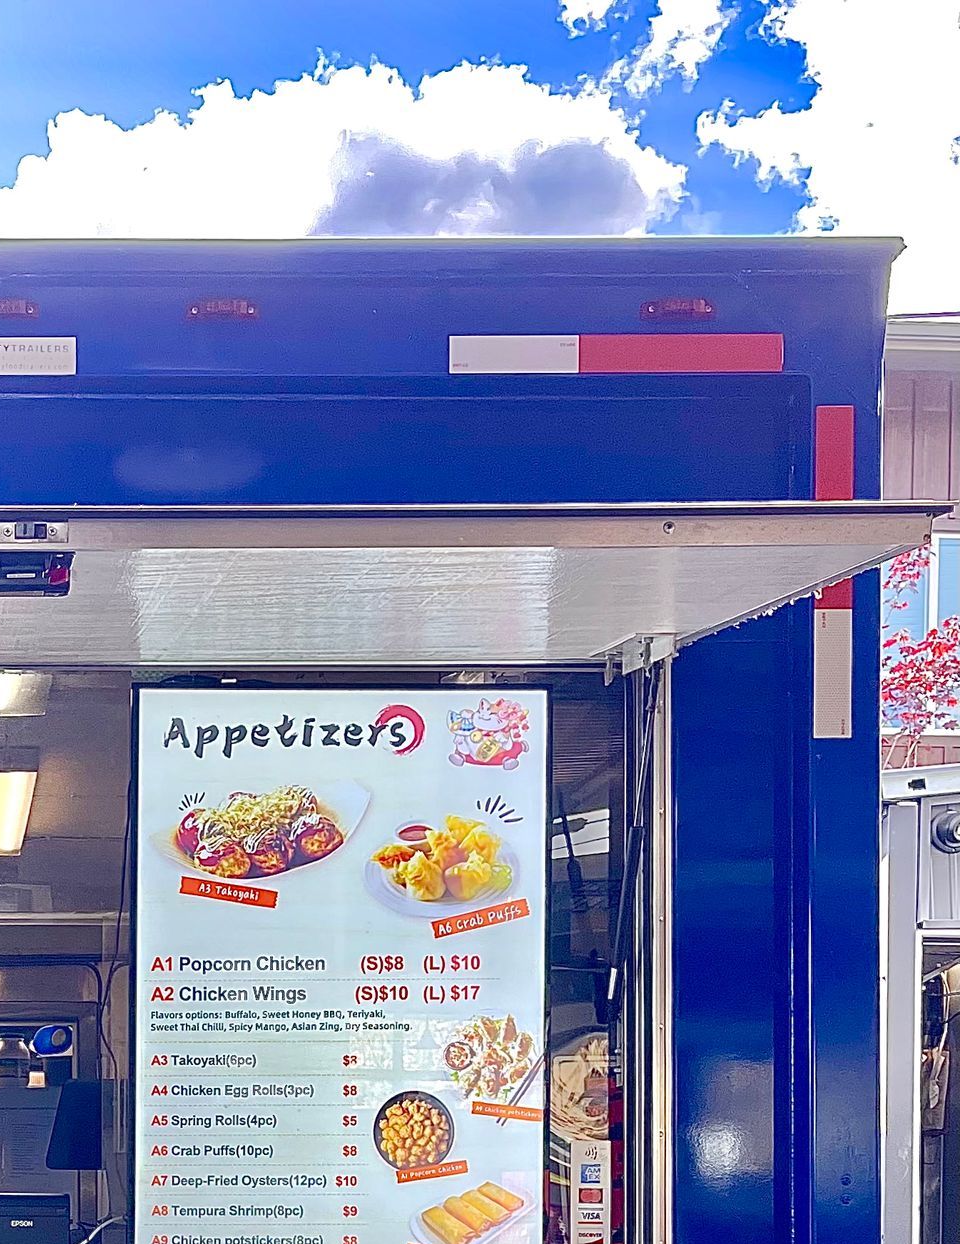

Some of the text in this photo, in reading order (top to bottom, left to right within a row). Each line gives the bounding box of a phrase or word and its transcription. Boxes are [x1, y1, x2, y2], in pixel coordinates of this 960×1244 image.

[163, 715, 407, 759] Appetizers
[199, 884, 259, 901] A3 Takoyaki
[151, 956, 480, 975] A1 Popcorn Chicken (S)$8 (L) $10
[151, 985, 480, 1006] A2 Chicken Wings (S)$10 (L) $17
[151, 1011, 183, 1019] Flavors
[185, 1011, 223, 1022] options:
[225, 1010, 258, 1021] Buffalo,
[262, 1010, 288, 1019] Sweet
[291, 1010, 320, 1022] Honey
[152, 1054, 168, 1067] A3
[171, 1053, 257, 1069] Takoyaki(6pc)
[152, 1083, 358, 1100] A4 Chicken Egg Rolls(3pc) $8
[152, 1113, 358, 1130] A5 Spring Rolls(4pc) $5
[152, 1143, 358, 1159] A6 Crab Puffs(10pc) $8
[152, 1174, 358, 1191] A7 Deep-Fried Oysters(12pc) $10
[152, 1204, 358, 1220] A8 Tempura Shrimp(8pc) $9
[582, 1211, 600, 1220] VISA
